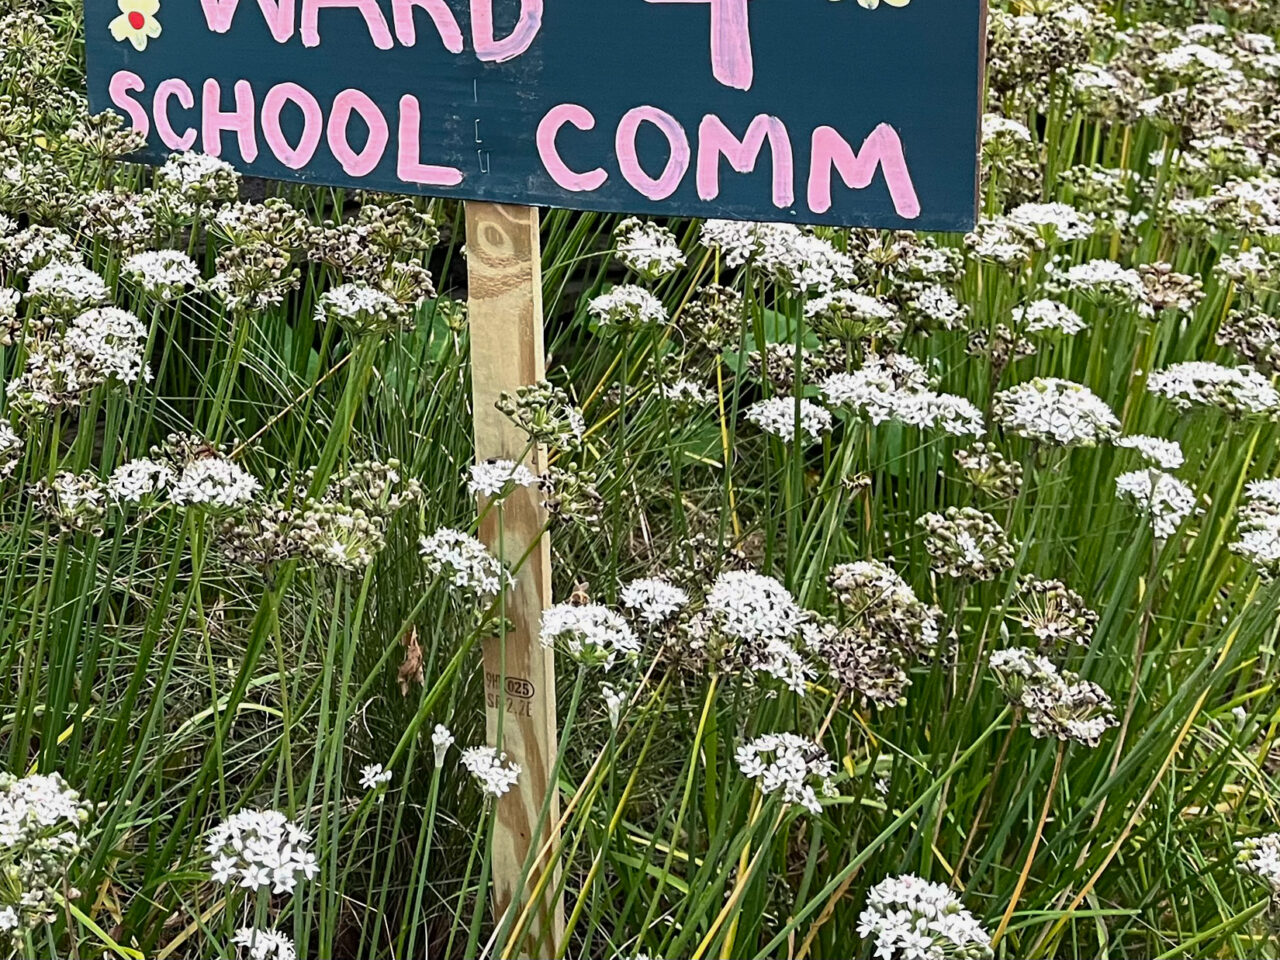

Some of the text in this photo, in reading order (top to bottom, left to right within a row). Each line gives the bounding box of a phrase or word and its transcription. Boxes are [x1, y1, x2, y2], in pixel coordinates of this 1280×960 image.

[109, 70, 921, 220] SCHOOL COMM
[507, 680, 529, 696] 025
